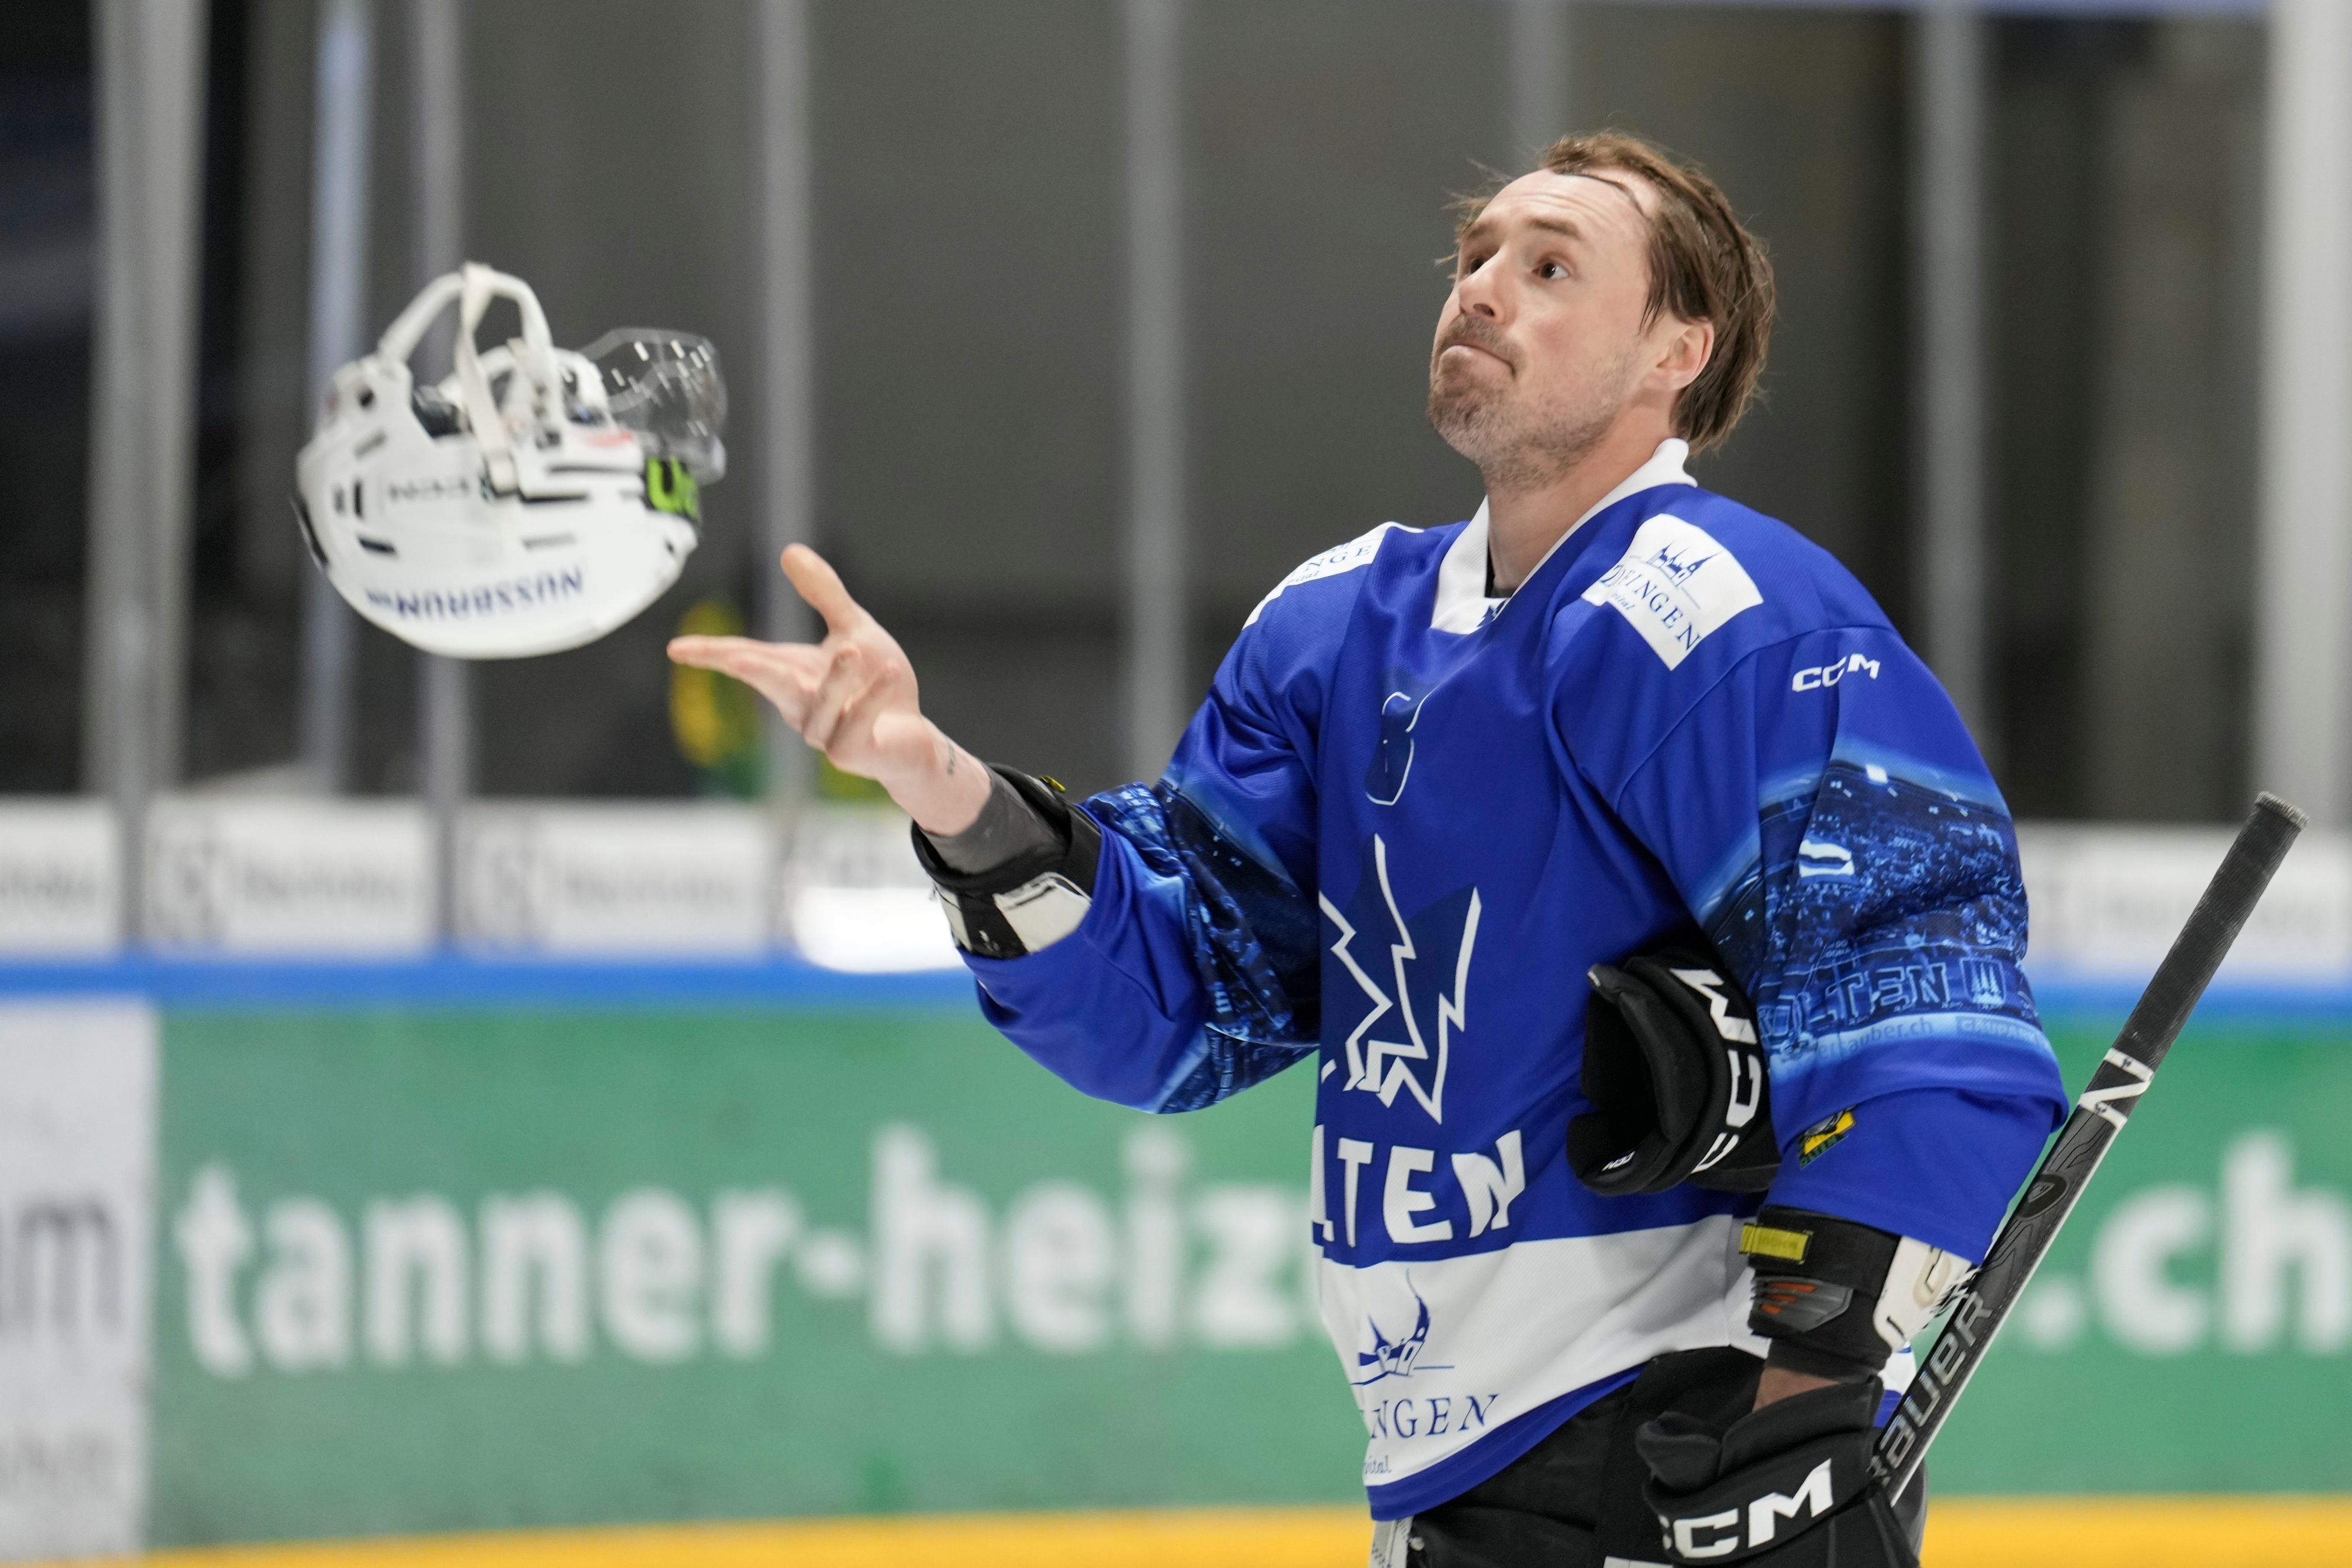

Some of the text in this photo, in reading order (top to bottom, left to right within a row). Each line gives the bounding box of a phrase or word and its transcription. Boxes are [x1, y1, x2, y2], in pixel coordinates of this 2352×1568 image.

[1792, 653, 1880, 693] CCM
[173, 1120, 1315, 1377] tanner-heiz
[1658, 1458, 1834, 1559] CM
